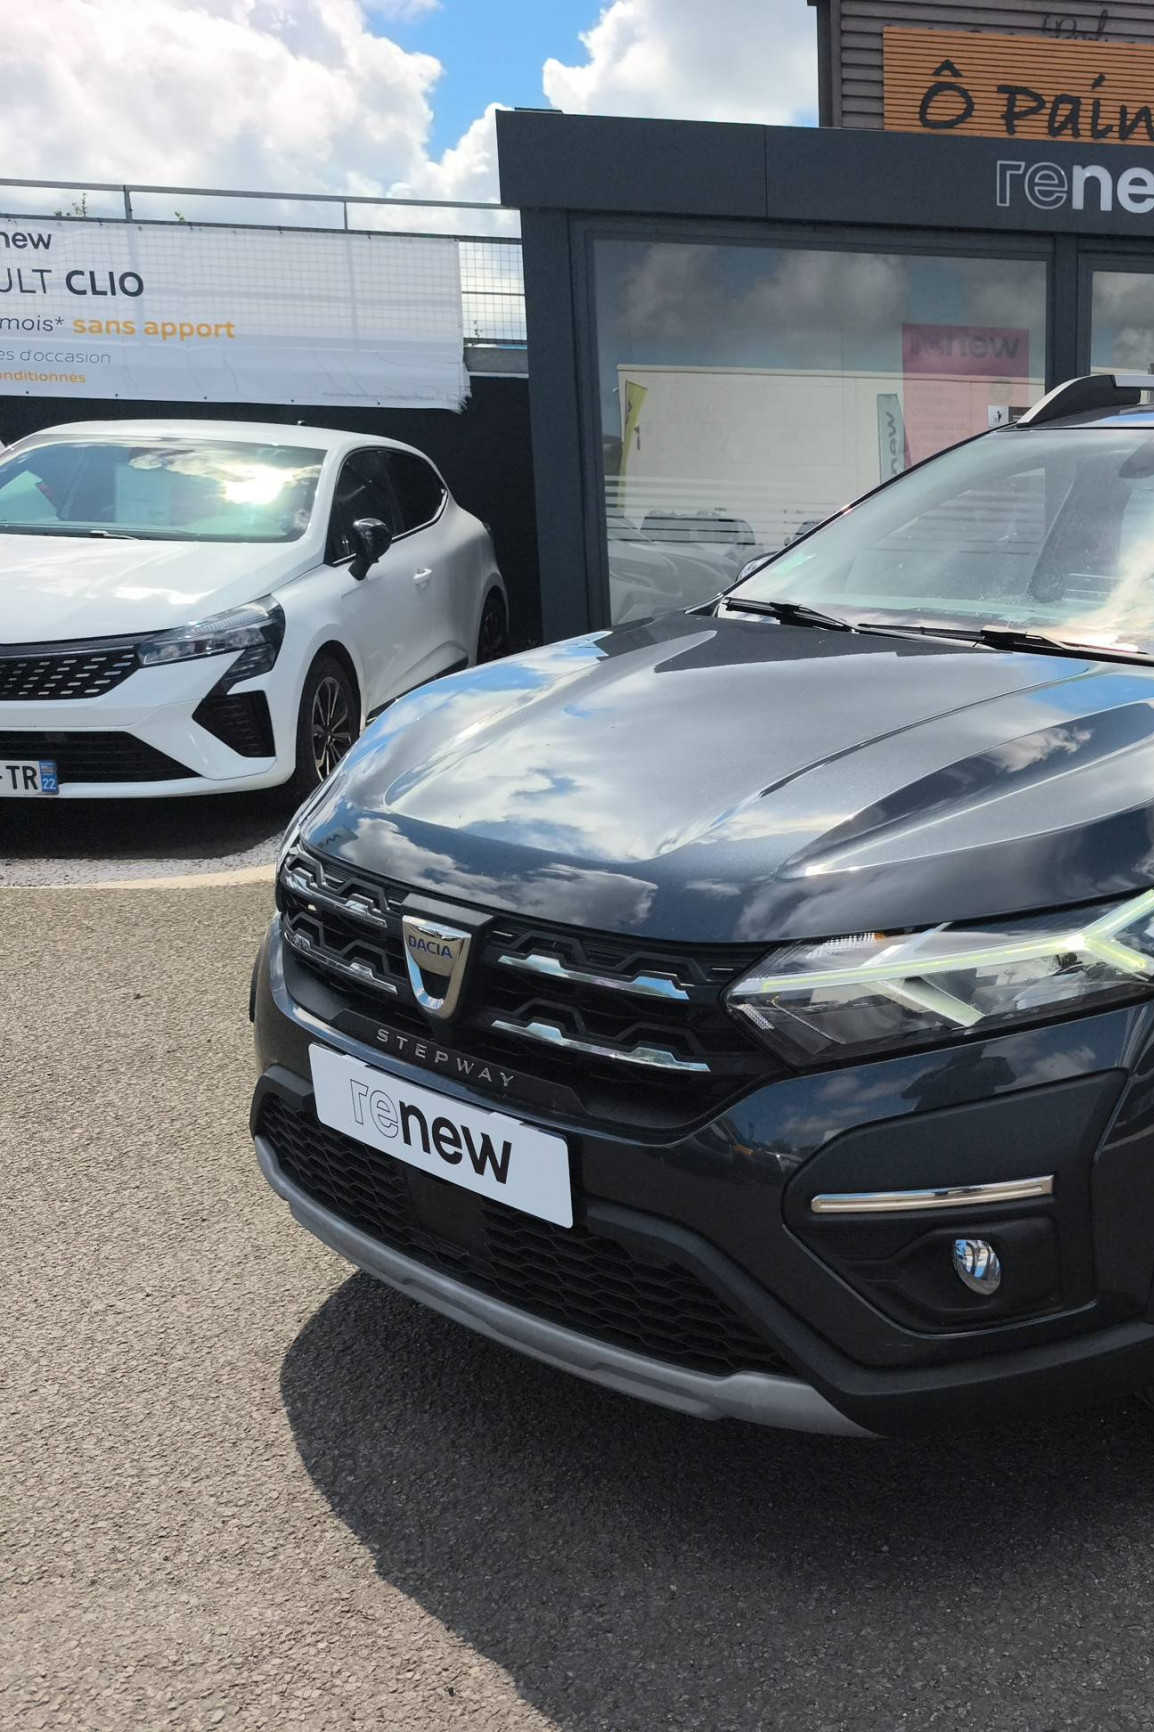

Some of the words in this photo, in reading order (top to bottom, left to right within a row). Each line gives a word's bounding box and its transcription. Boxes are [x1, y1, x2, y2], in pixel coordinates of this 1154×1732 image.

[920, 59, 975, 129] Ô
[65, 269, 144, 297] CLIO
[72, 319, 136, 335] sans
[144, 321, 236, 342] apport
[20, 348, 111, 364] d'occasion
[910, 333, 1021, 360] renew
[42, 778, 57, 790] 22
[408, 934, 453, 959] DACIA
[375, 1027, 516, 1089] STEPWAY
[349, 1077, 512, 1185] renew
